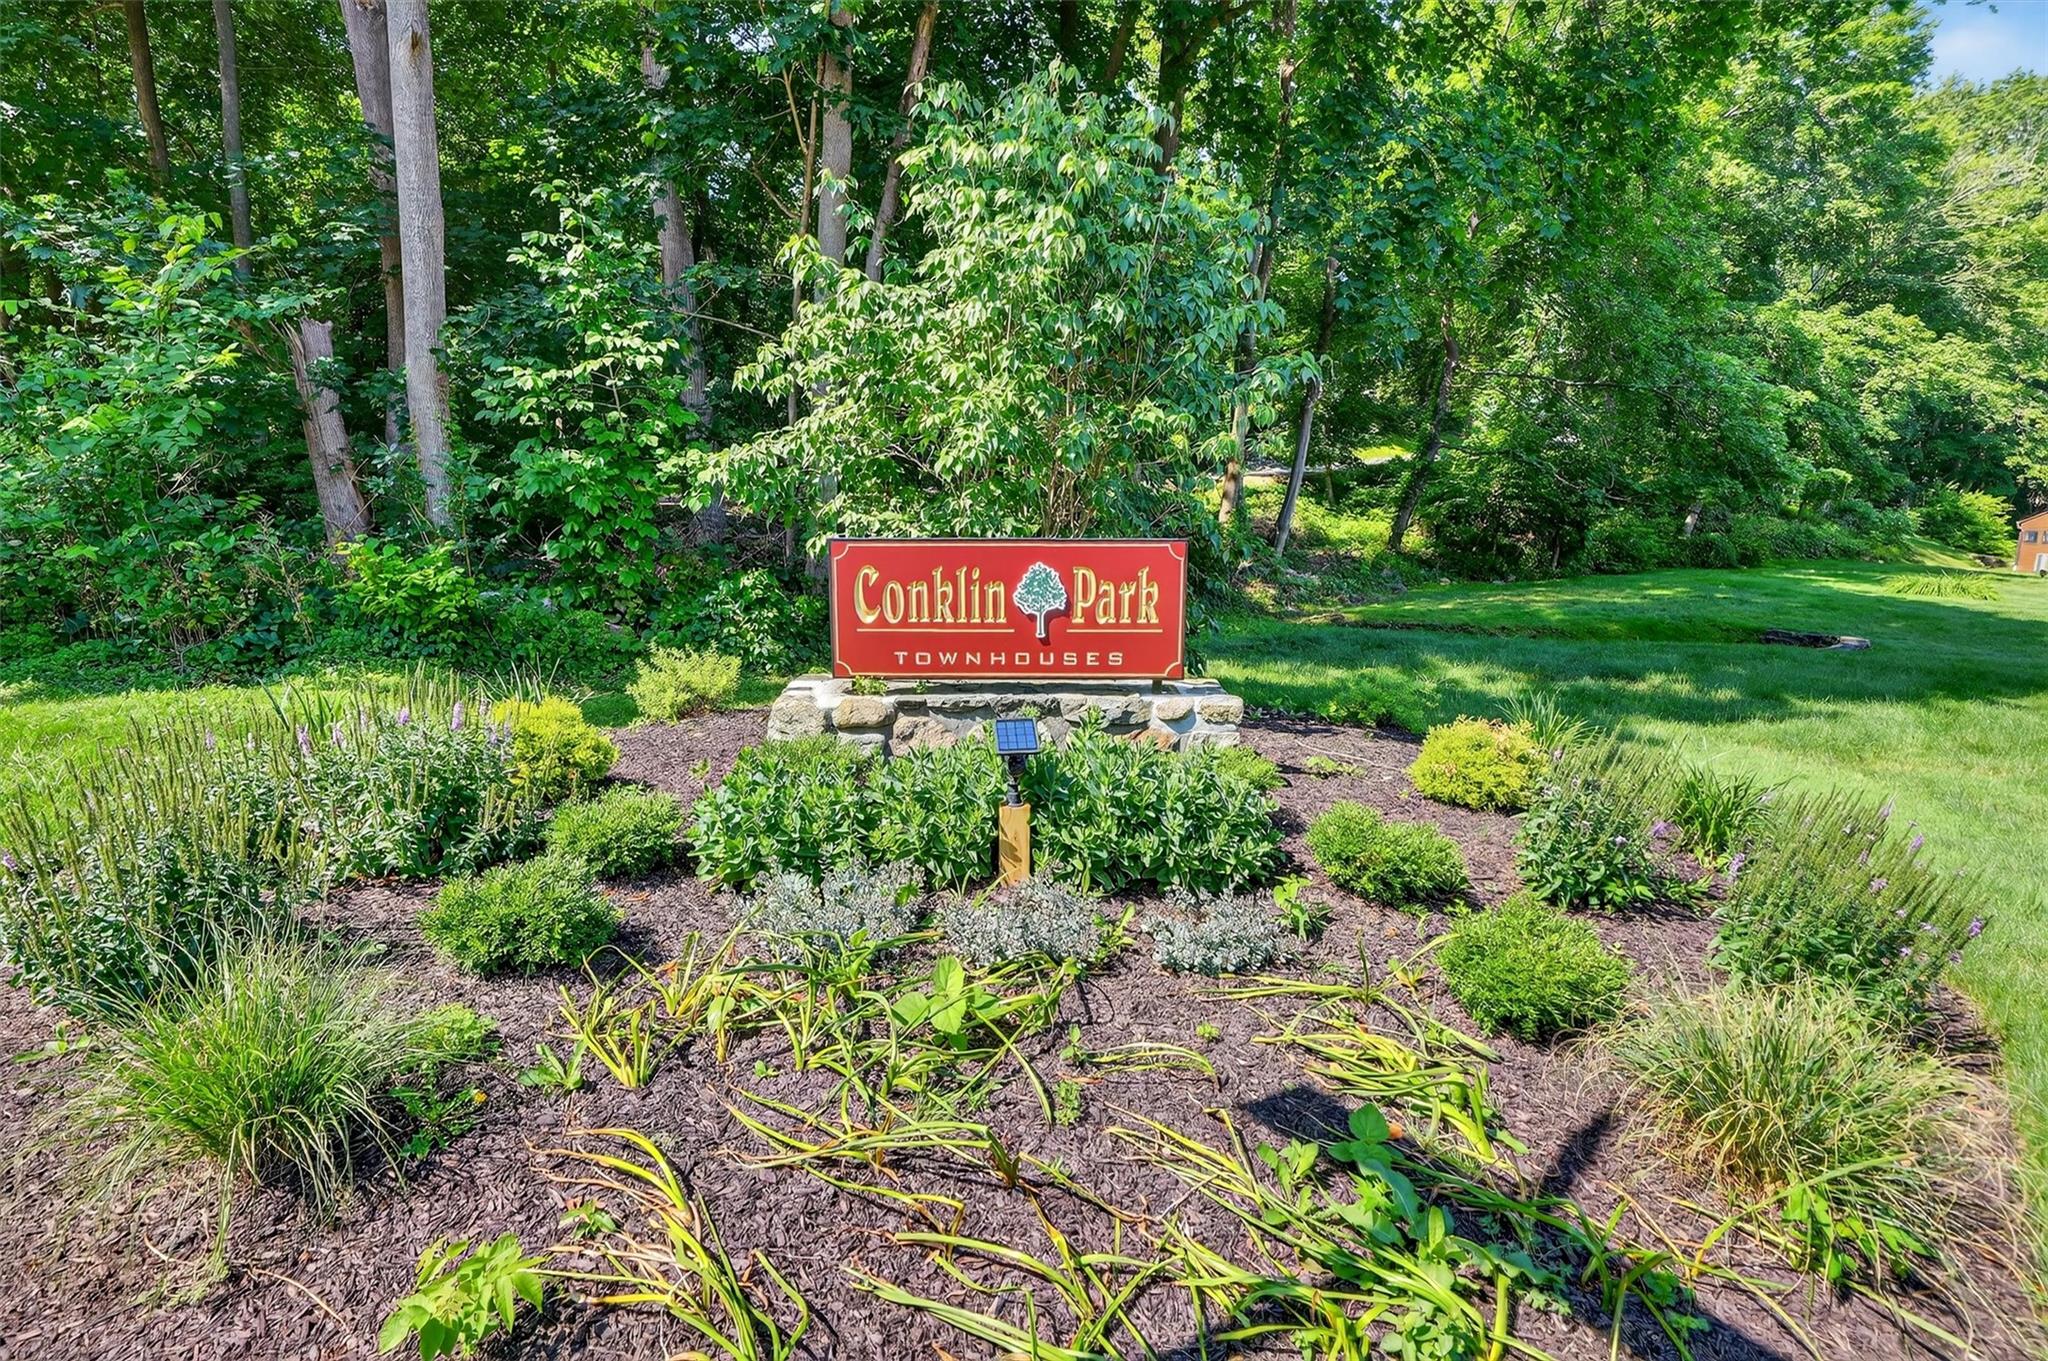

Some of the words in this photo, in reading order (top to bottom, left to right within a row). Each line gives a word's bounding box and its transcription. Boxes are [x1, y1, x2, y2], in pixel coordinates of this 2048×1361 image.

[854, 564, 1007, 624] Conklin
[1071, 565, 1160, 625] Park
[894, 651, 1124, 666] TOWNHOUSES
